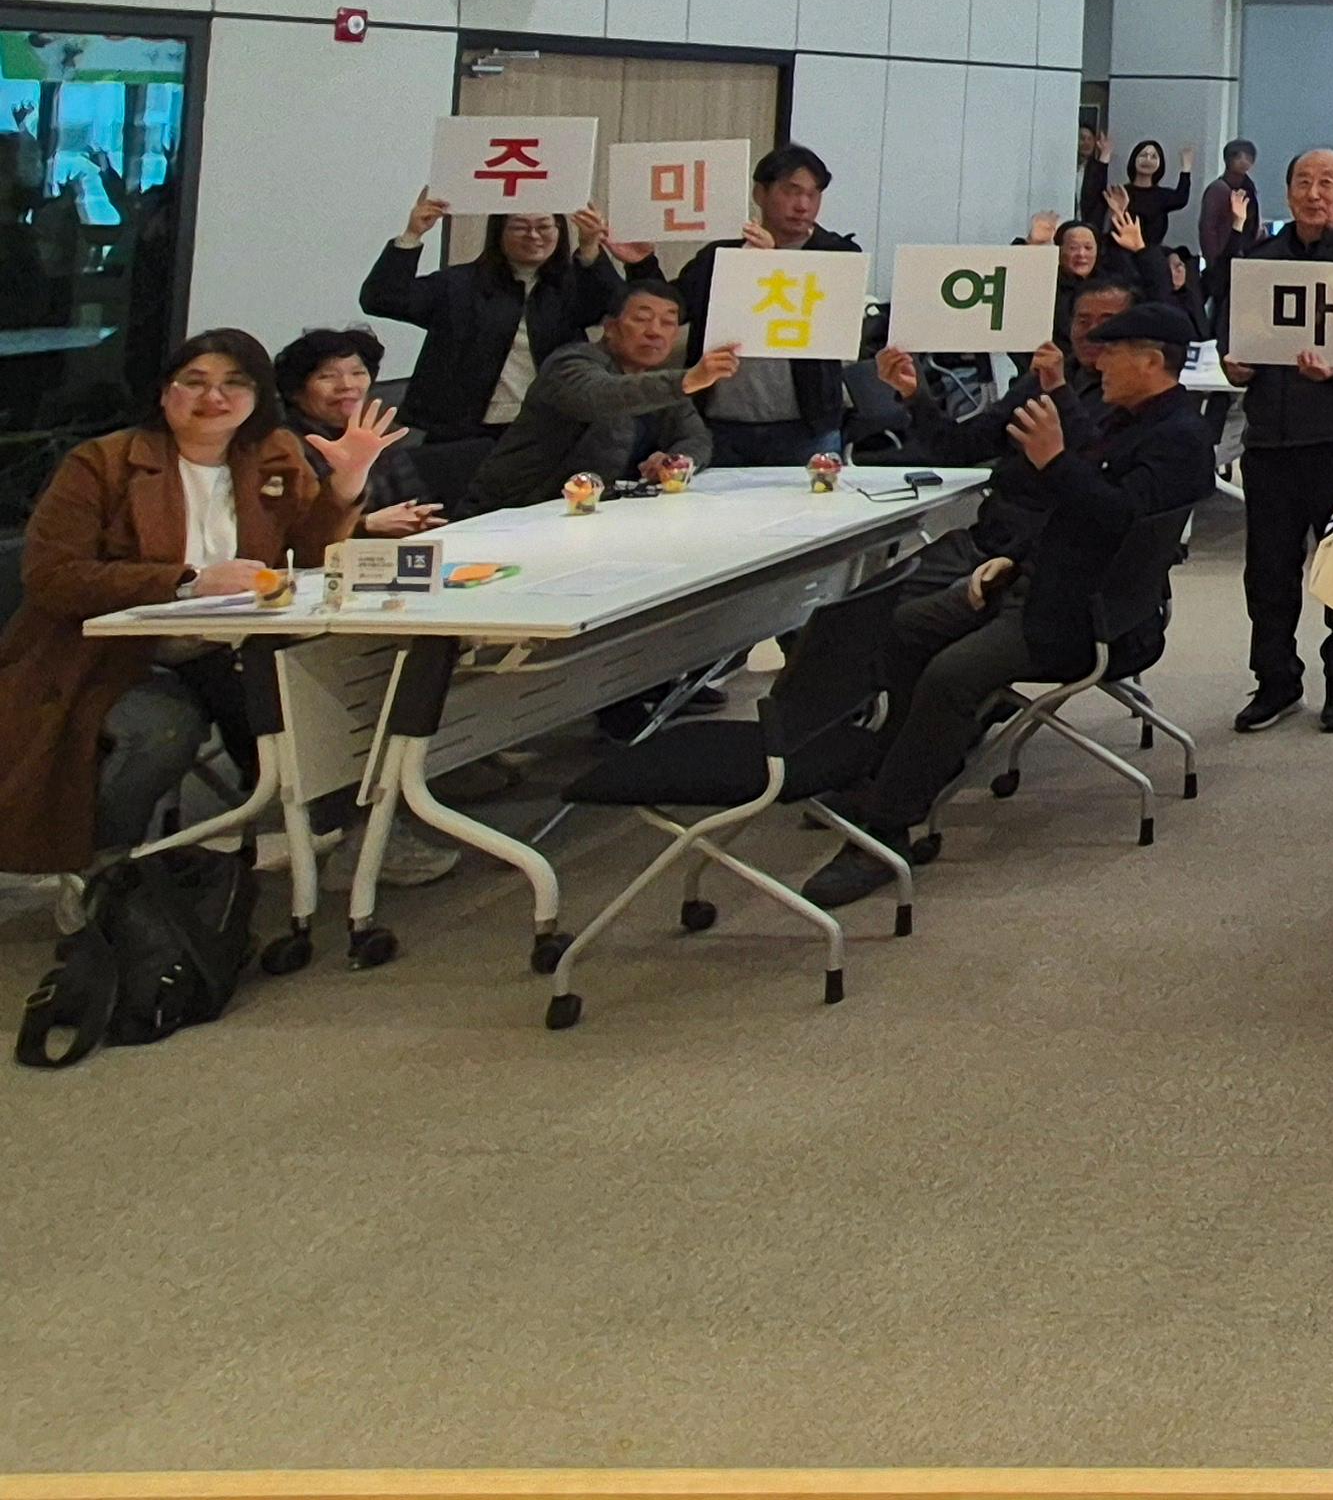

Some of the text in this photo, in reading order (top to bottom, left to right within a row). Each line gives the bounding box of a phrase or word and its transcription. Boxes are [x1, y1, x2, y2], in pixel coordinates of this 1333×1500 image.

[474, 138, 548, 197] 주
[650, 160, 706, 231] 민
[753, 268, 824, 348] 참
[941, 266, 1007, 331] 여
[405, 554, 426, 568] 1조
